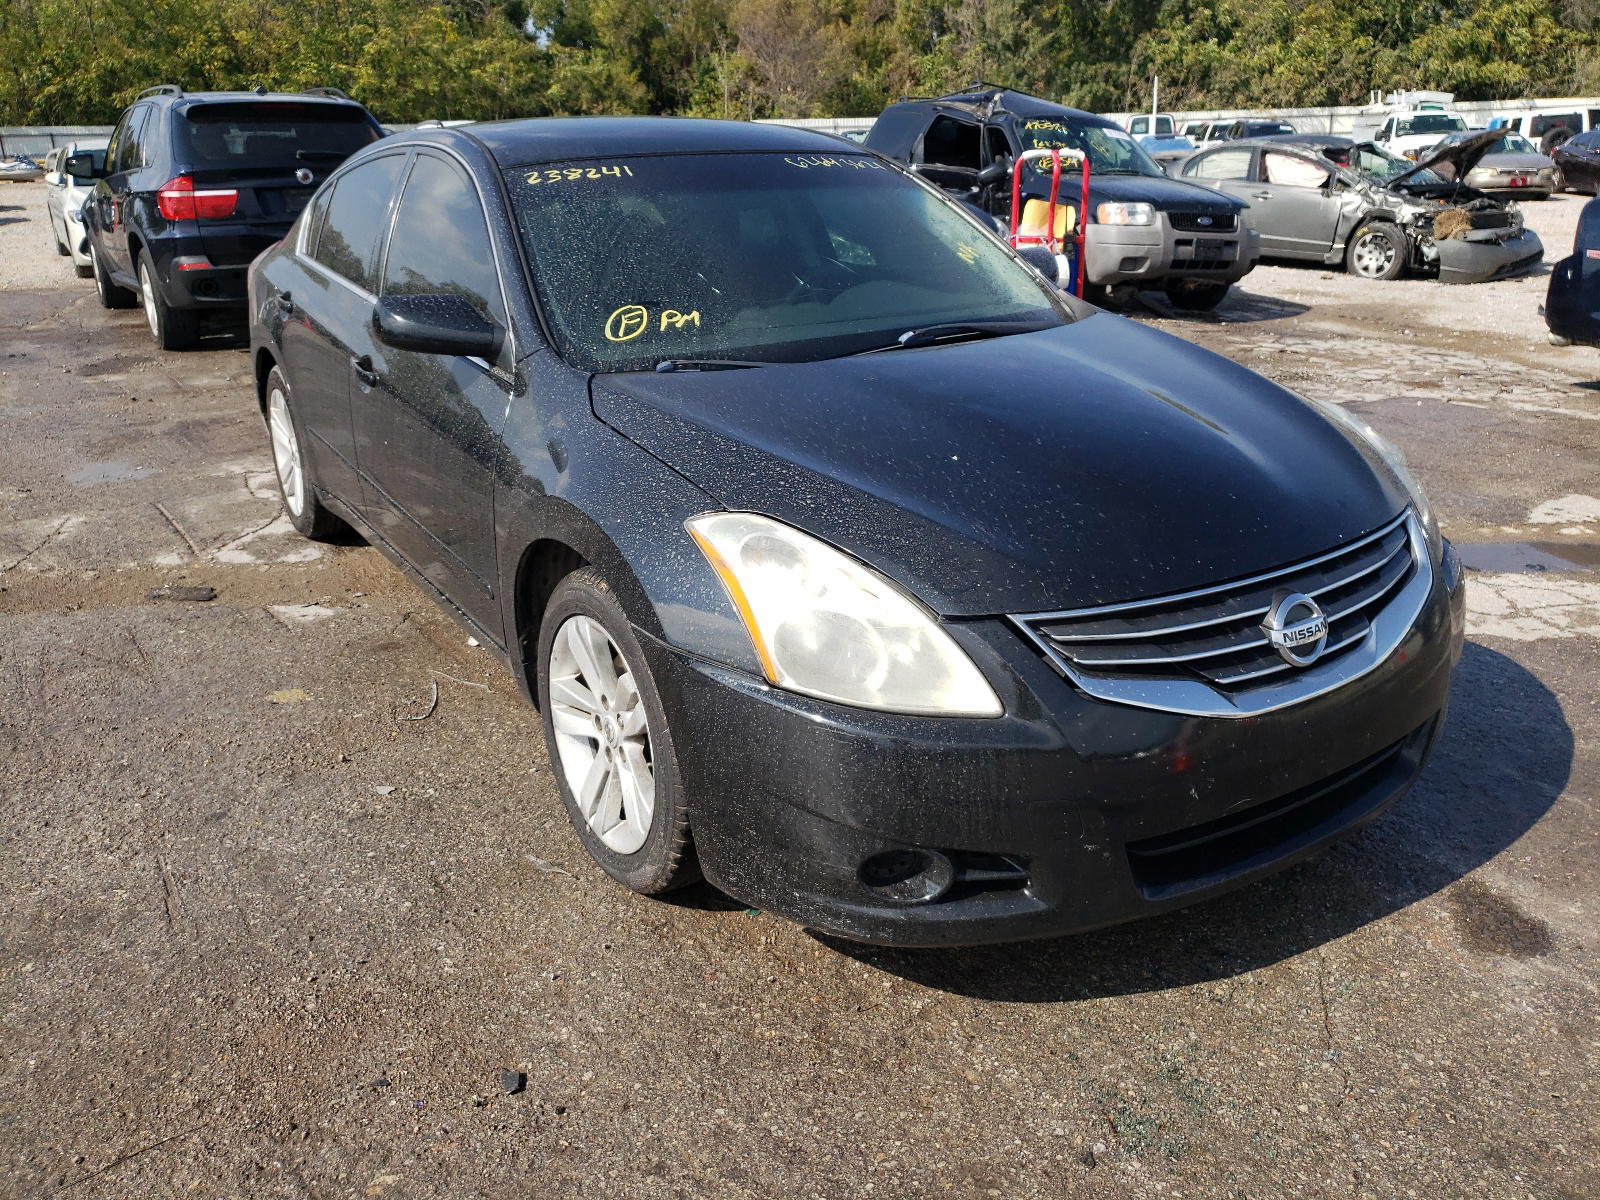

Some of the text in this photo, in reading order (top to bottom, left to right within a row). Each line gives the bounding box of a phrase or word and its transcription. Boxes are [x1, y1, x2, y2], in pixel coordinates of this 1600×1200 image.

[524, 165, 633, 184] 238241
[618, 309, 643, 338] F
[1283, 621, 1327, 643] NISSAN
